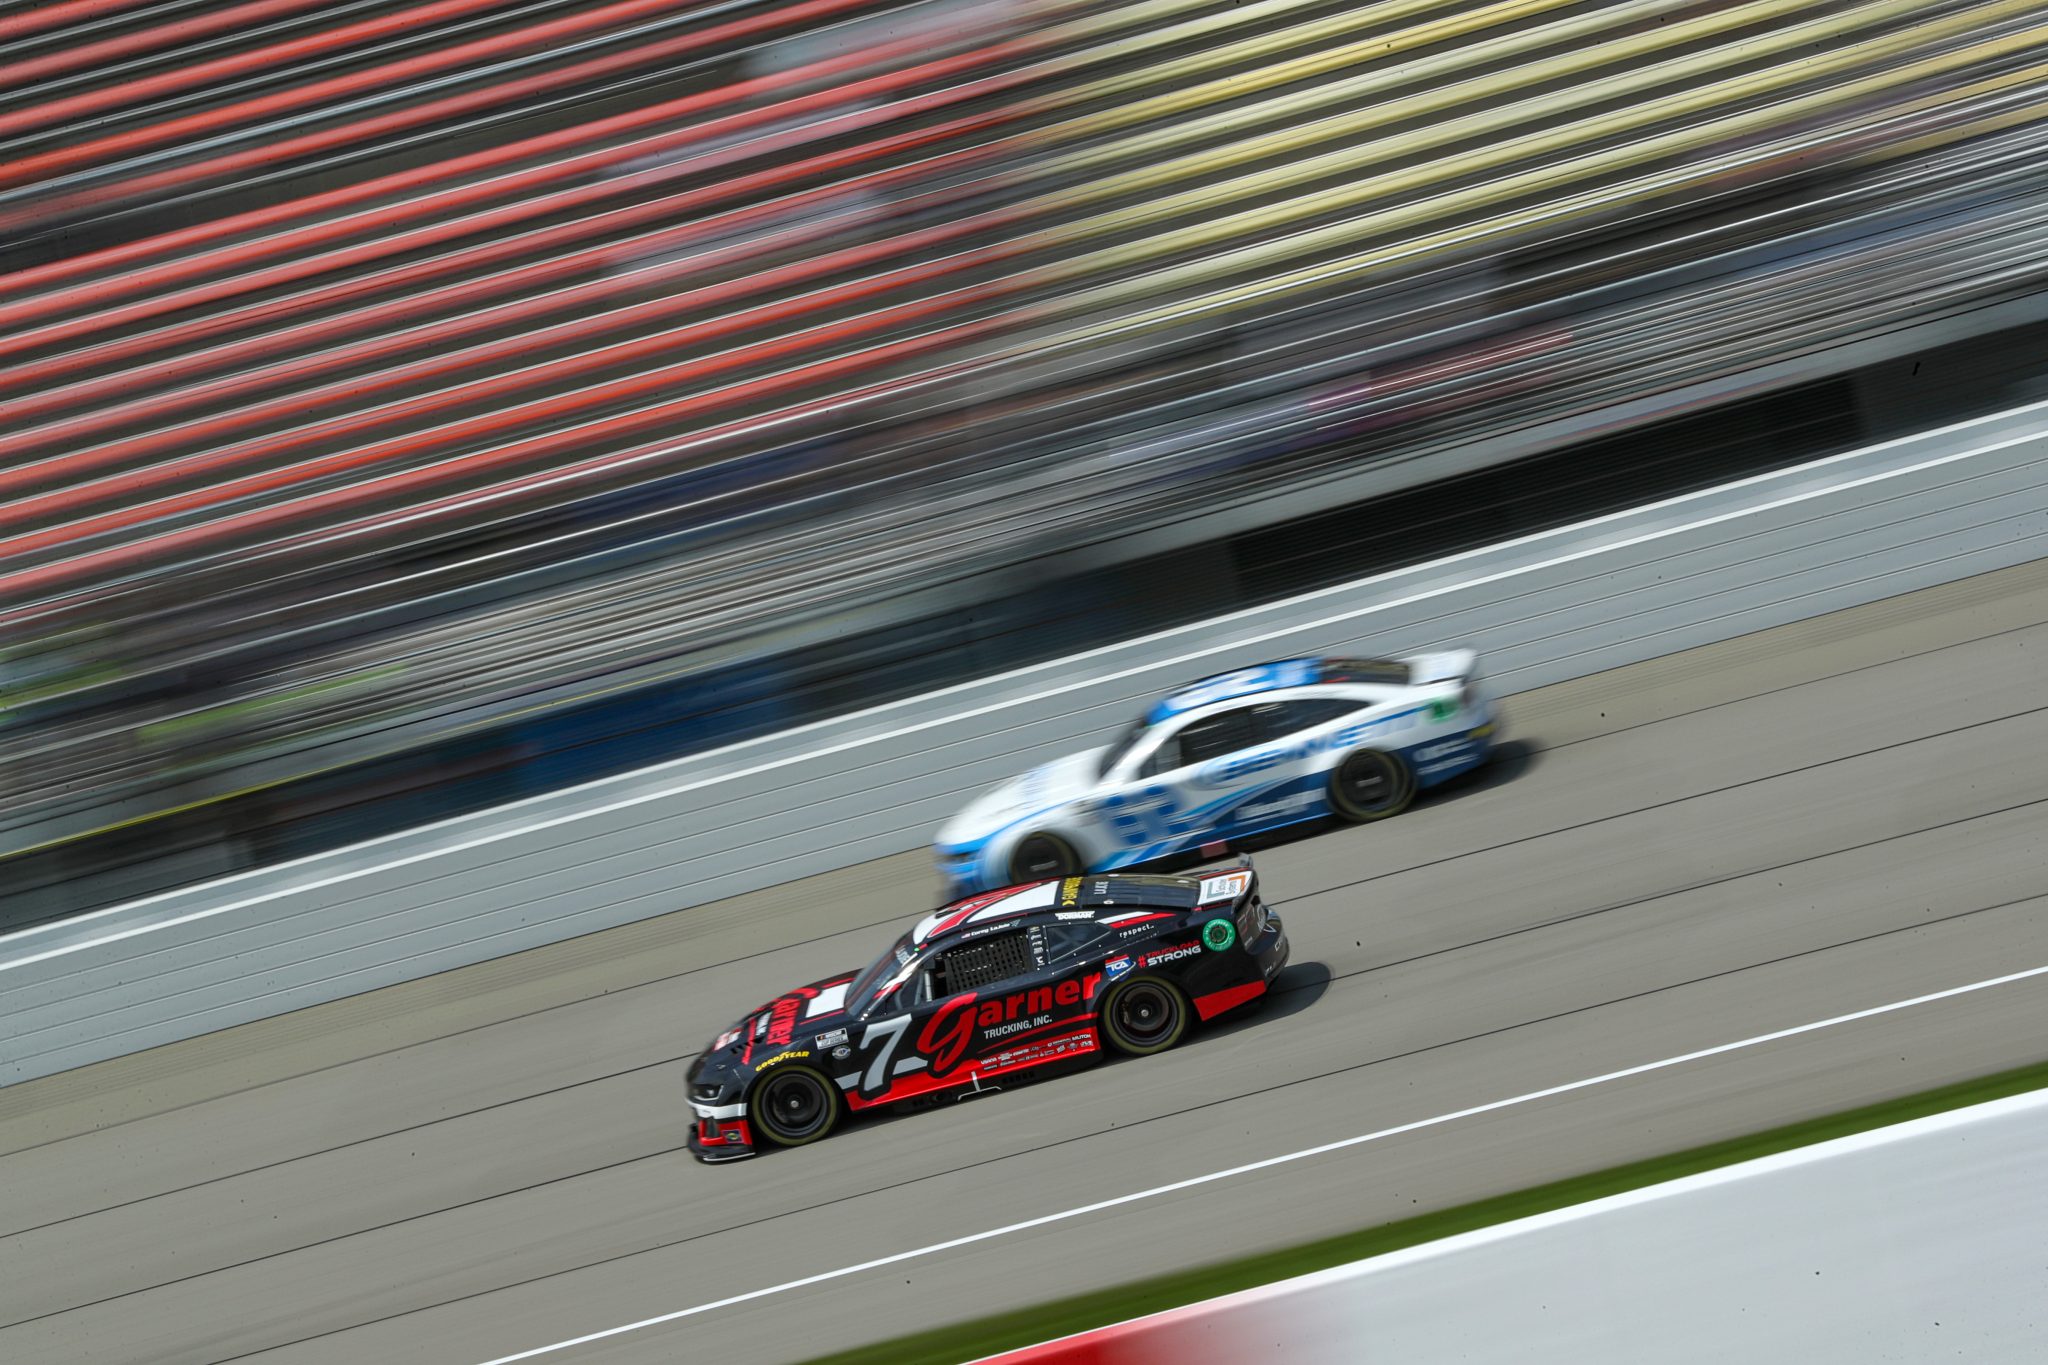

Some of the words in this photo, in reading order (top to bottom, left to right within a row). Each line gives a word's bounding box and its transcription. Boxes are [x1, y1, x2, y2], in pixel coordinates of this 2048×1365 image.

[1147, 945, 1202, 967] STRONG
[984, 1019, 1032, 1040] TRUCKING,
[1034, 1014, 1053, 1028] INC.
[755, 1050, 810, 1072] GOODYEAR
[859, 1013, 913, 1092] 7
